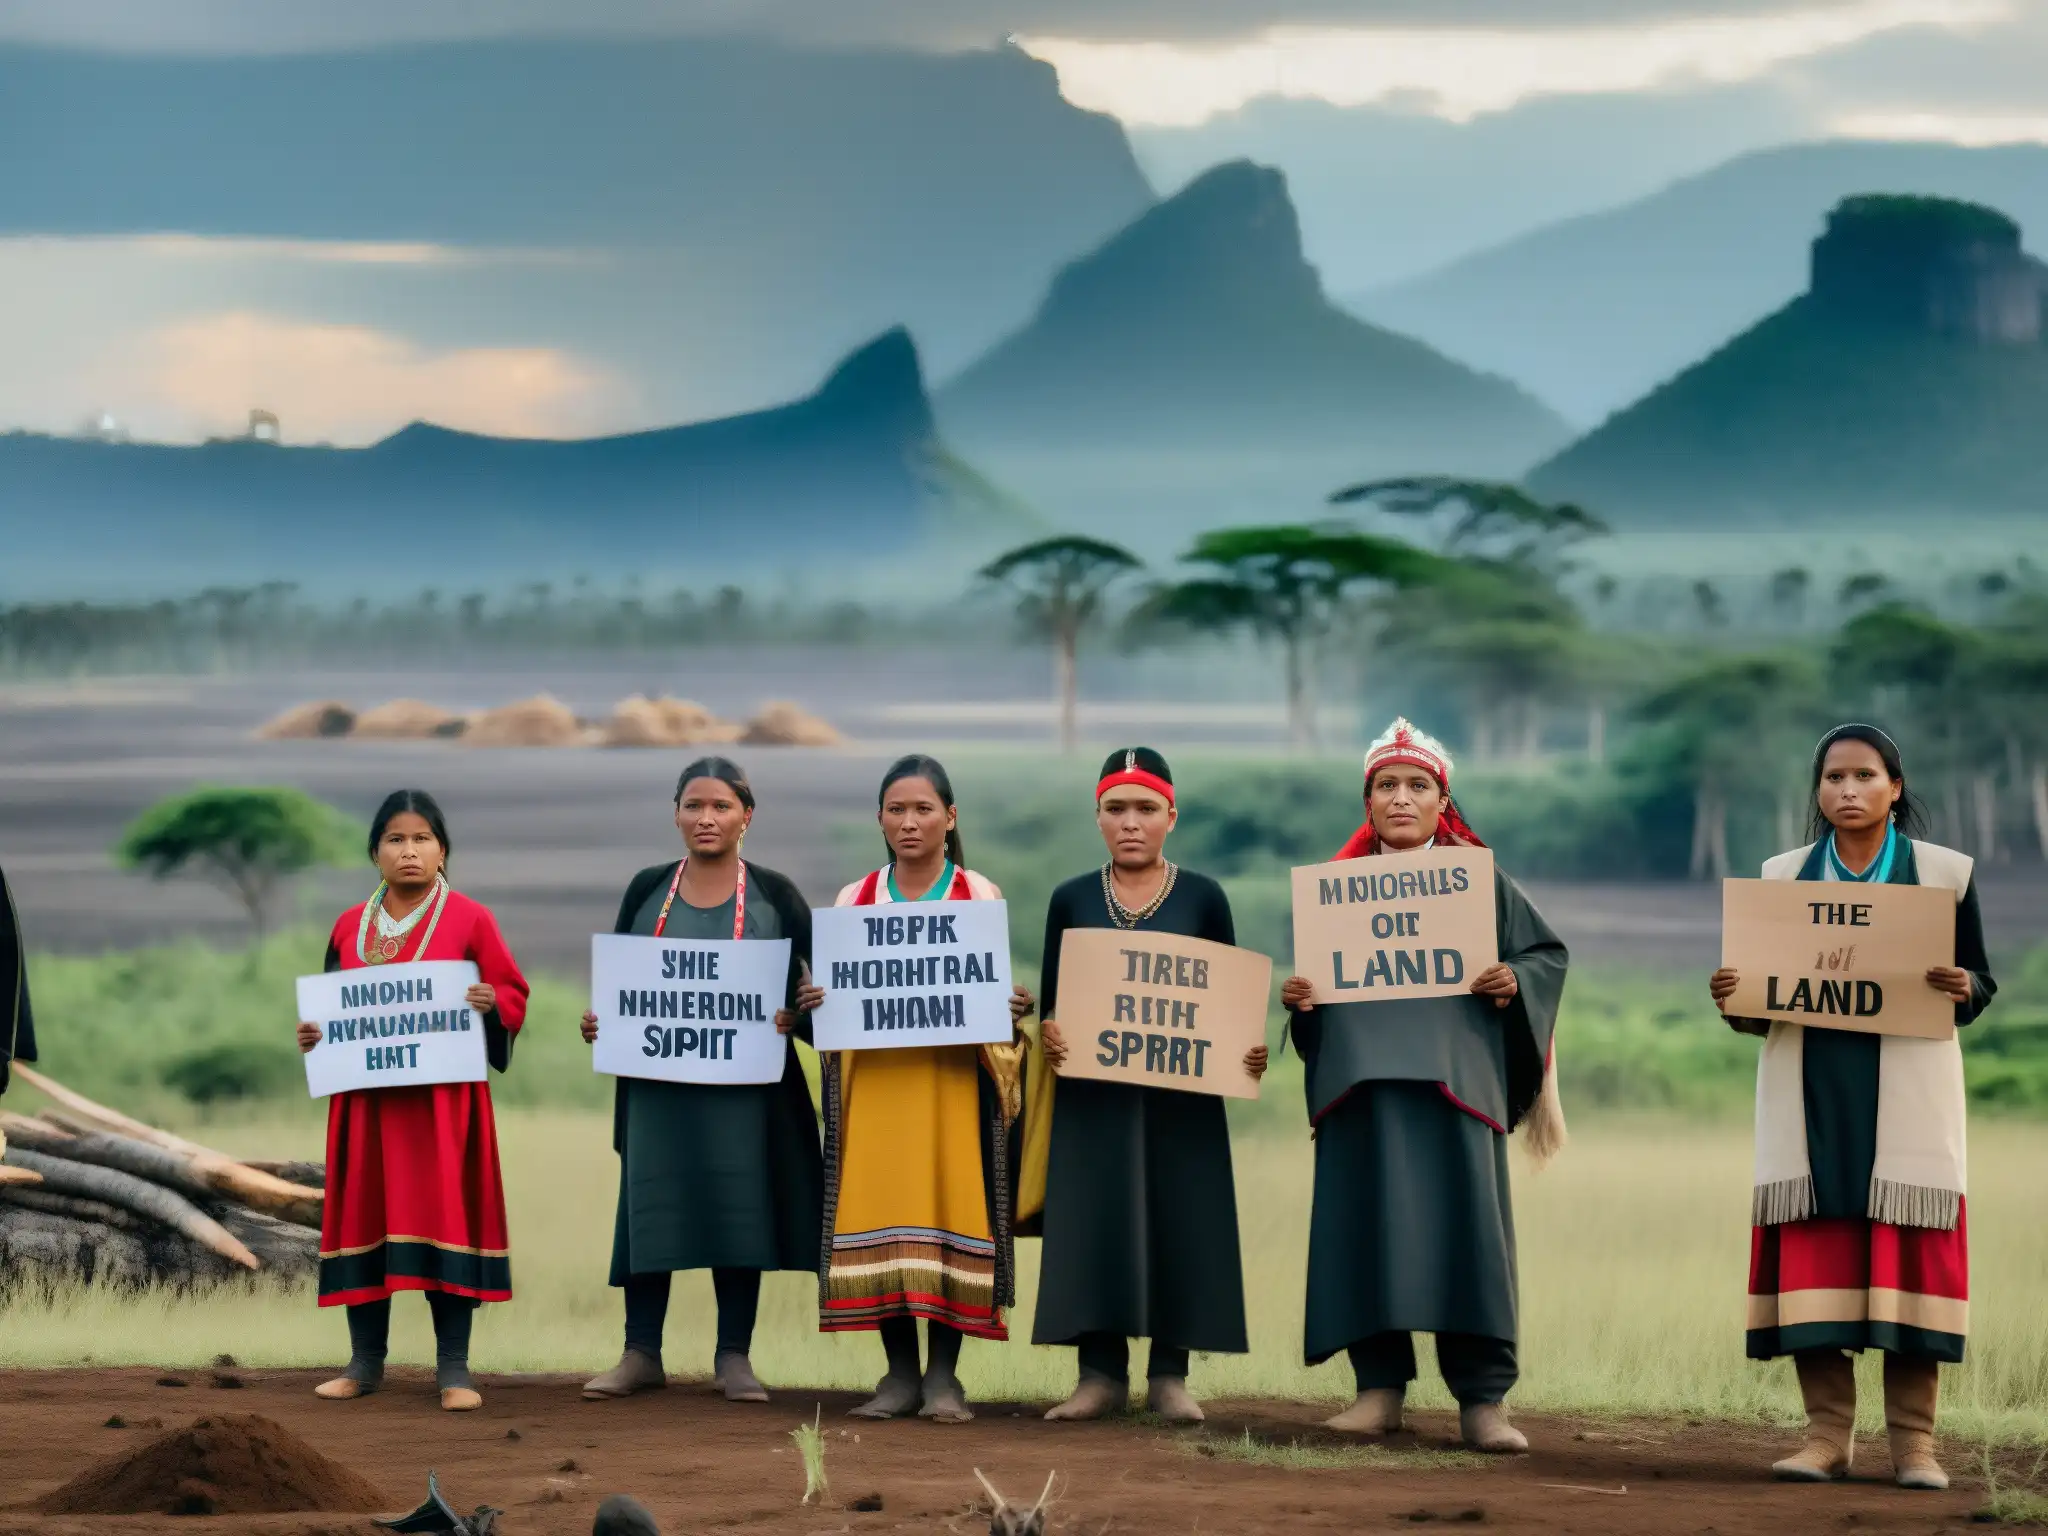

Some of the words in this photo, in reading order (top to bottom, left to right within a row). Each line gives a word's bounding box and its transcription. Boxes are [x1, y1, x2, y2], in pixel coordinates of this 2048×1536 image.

[1808, 902, 1872, 927] THE
[1332, 948, 1464, 990] LAND
[619, 989, 767, 1022] NHNERONL
[1767, 976, 1883, 1017] LAND
